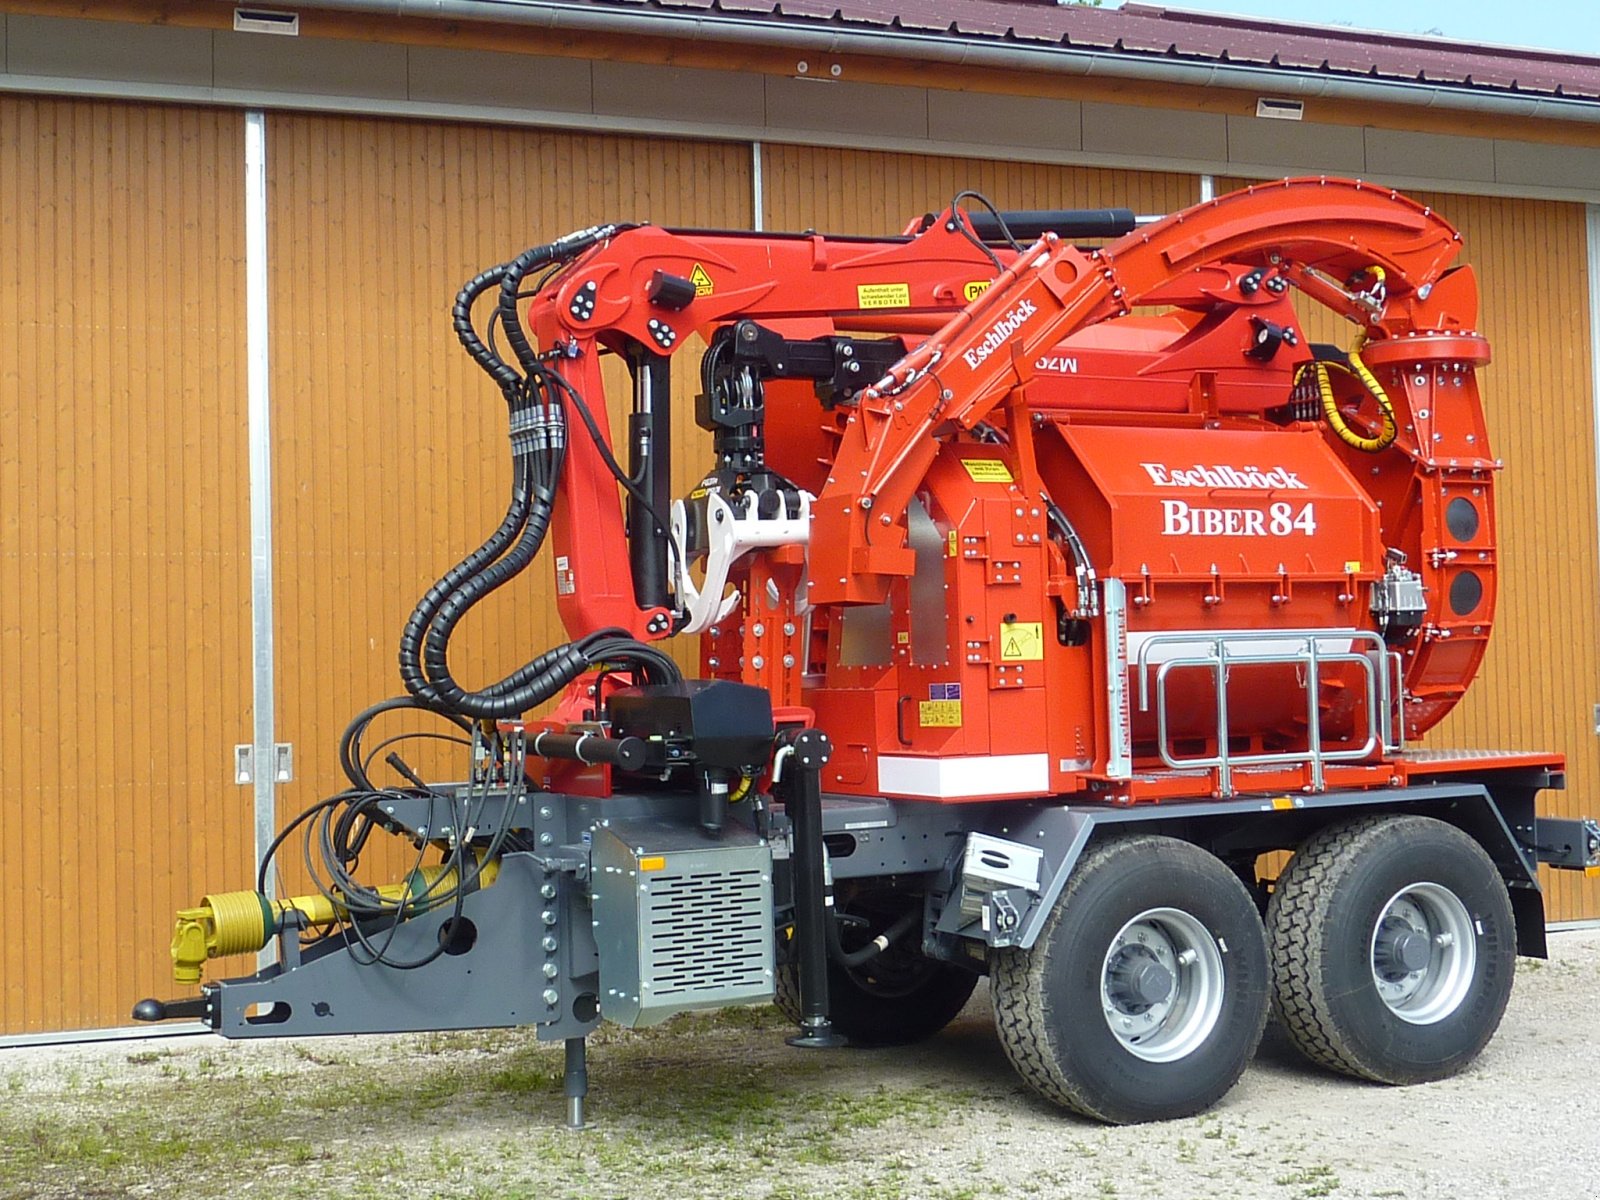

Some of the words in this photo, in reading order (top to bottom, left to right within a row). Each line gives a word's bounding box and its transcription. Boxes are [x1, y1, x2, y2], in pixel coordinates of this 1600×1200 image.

[962, 299, 1037, 371] Eschlböck
[1139, 463, 1309, 489] Eschlböck
[1160, 500, 1267, 536] BIBER
[1269, 502, 1317, 536] 84
